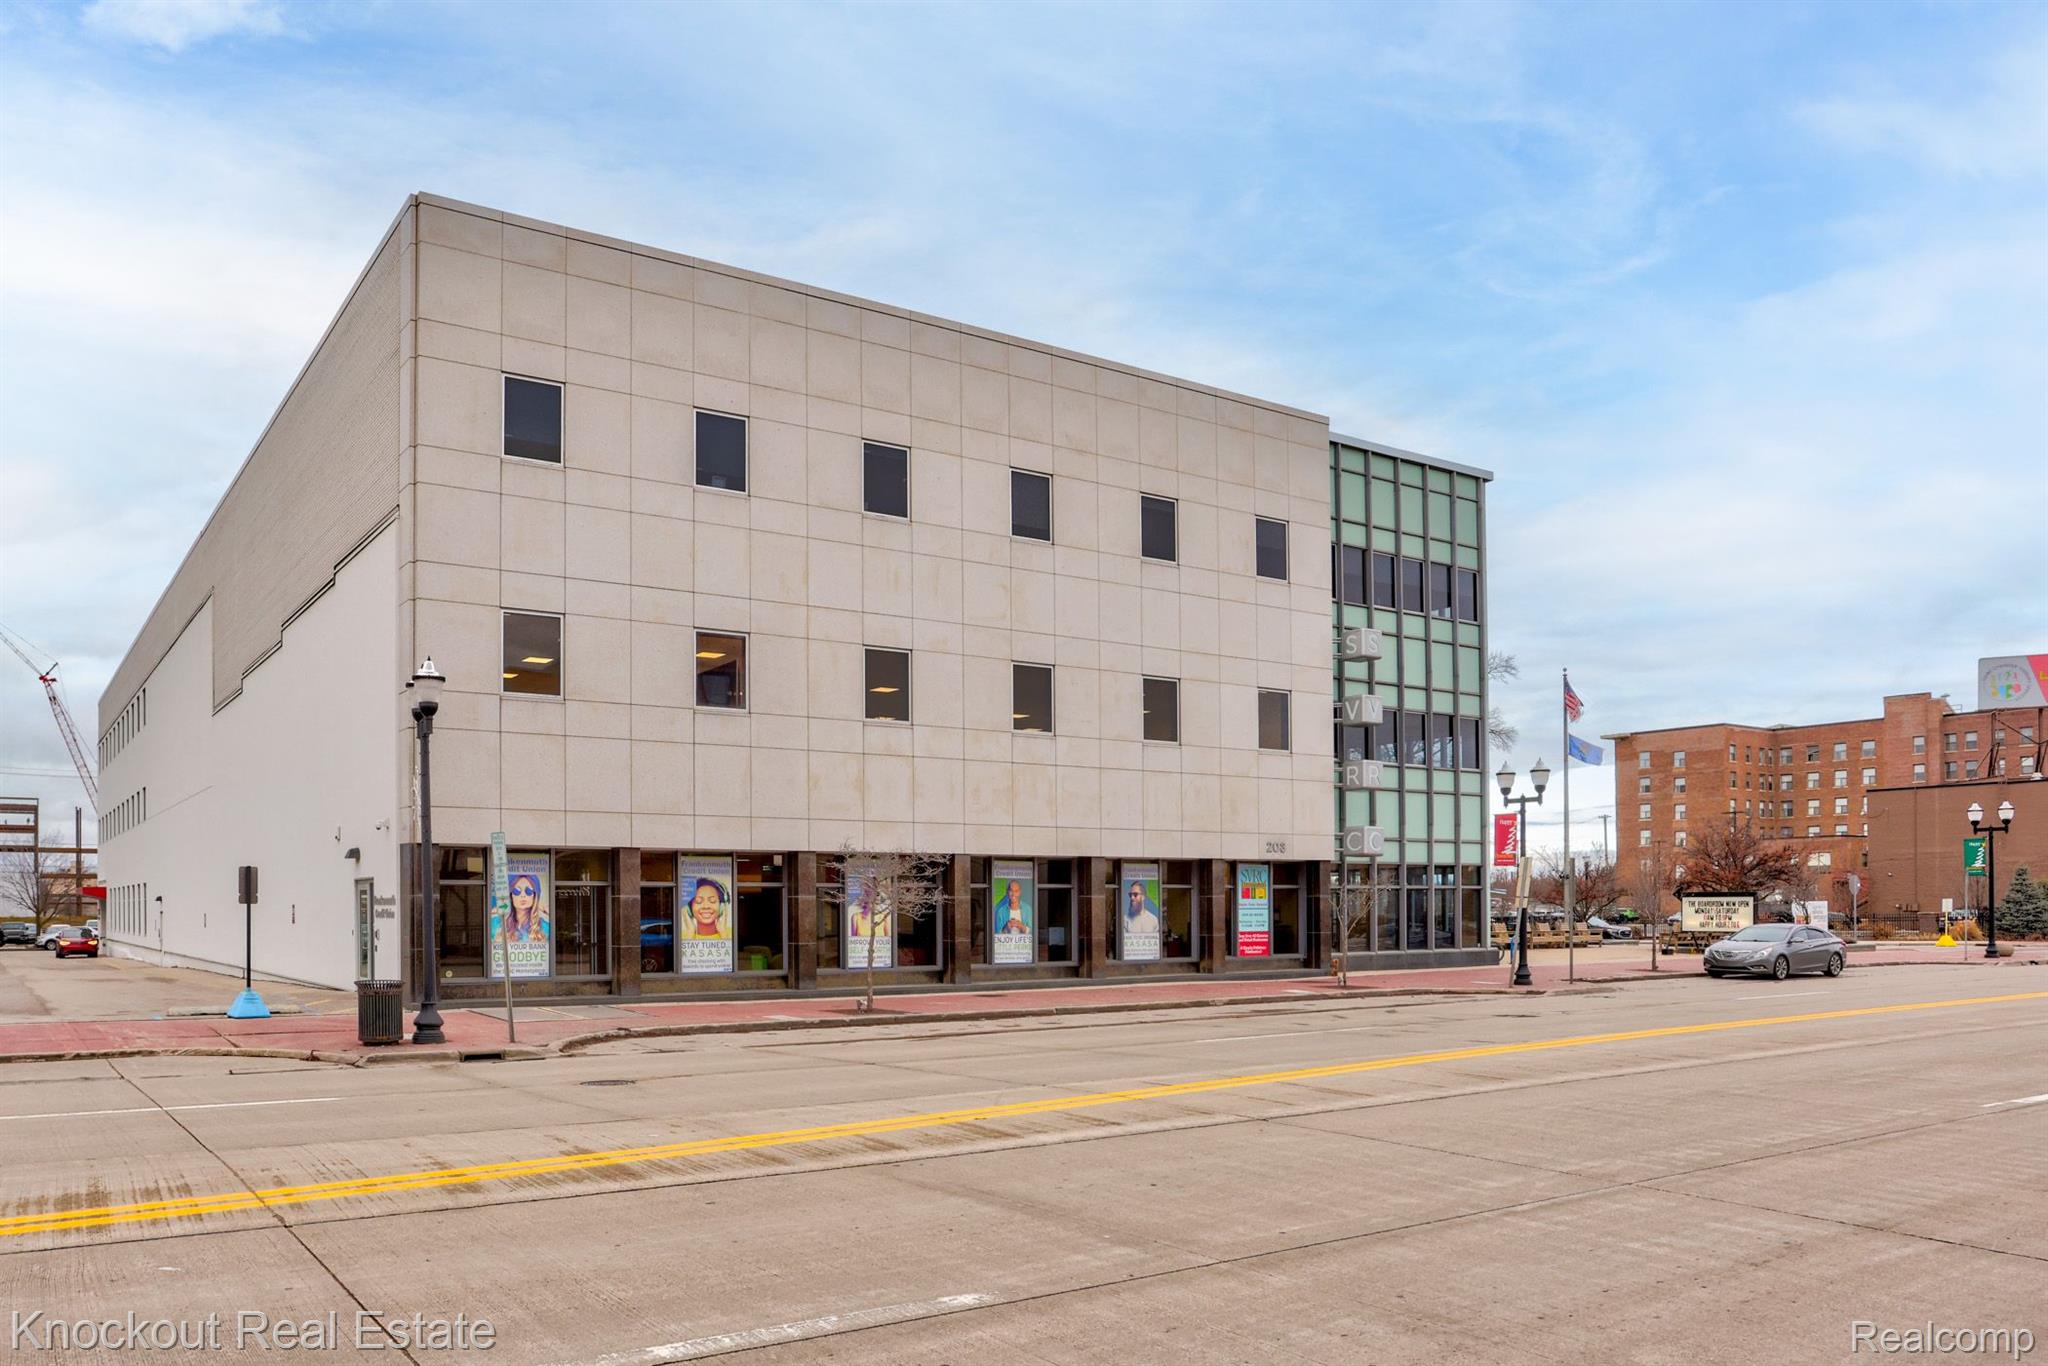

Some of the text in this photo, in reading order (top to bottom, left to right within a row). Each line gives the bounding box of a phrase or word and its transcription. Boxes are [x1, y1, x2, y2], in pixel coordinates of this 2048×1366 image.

[1265, 842, 1286, 853] 208
[1240, 868, 1268, 882] SVRC
[528, 943, 547, 951] BANK
[680, 941, 699, 950] STAY
[493, 950, 548, 962] GODBYE
[680, 949, 731, 958] KASASA
